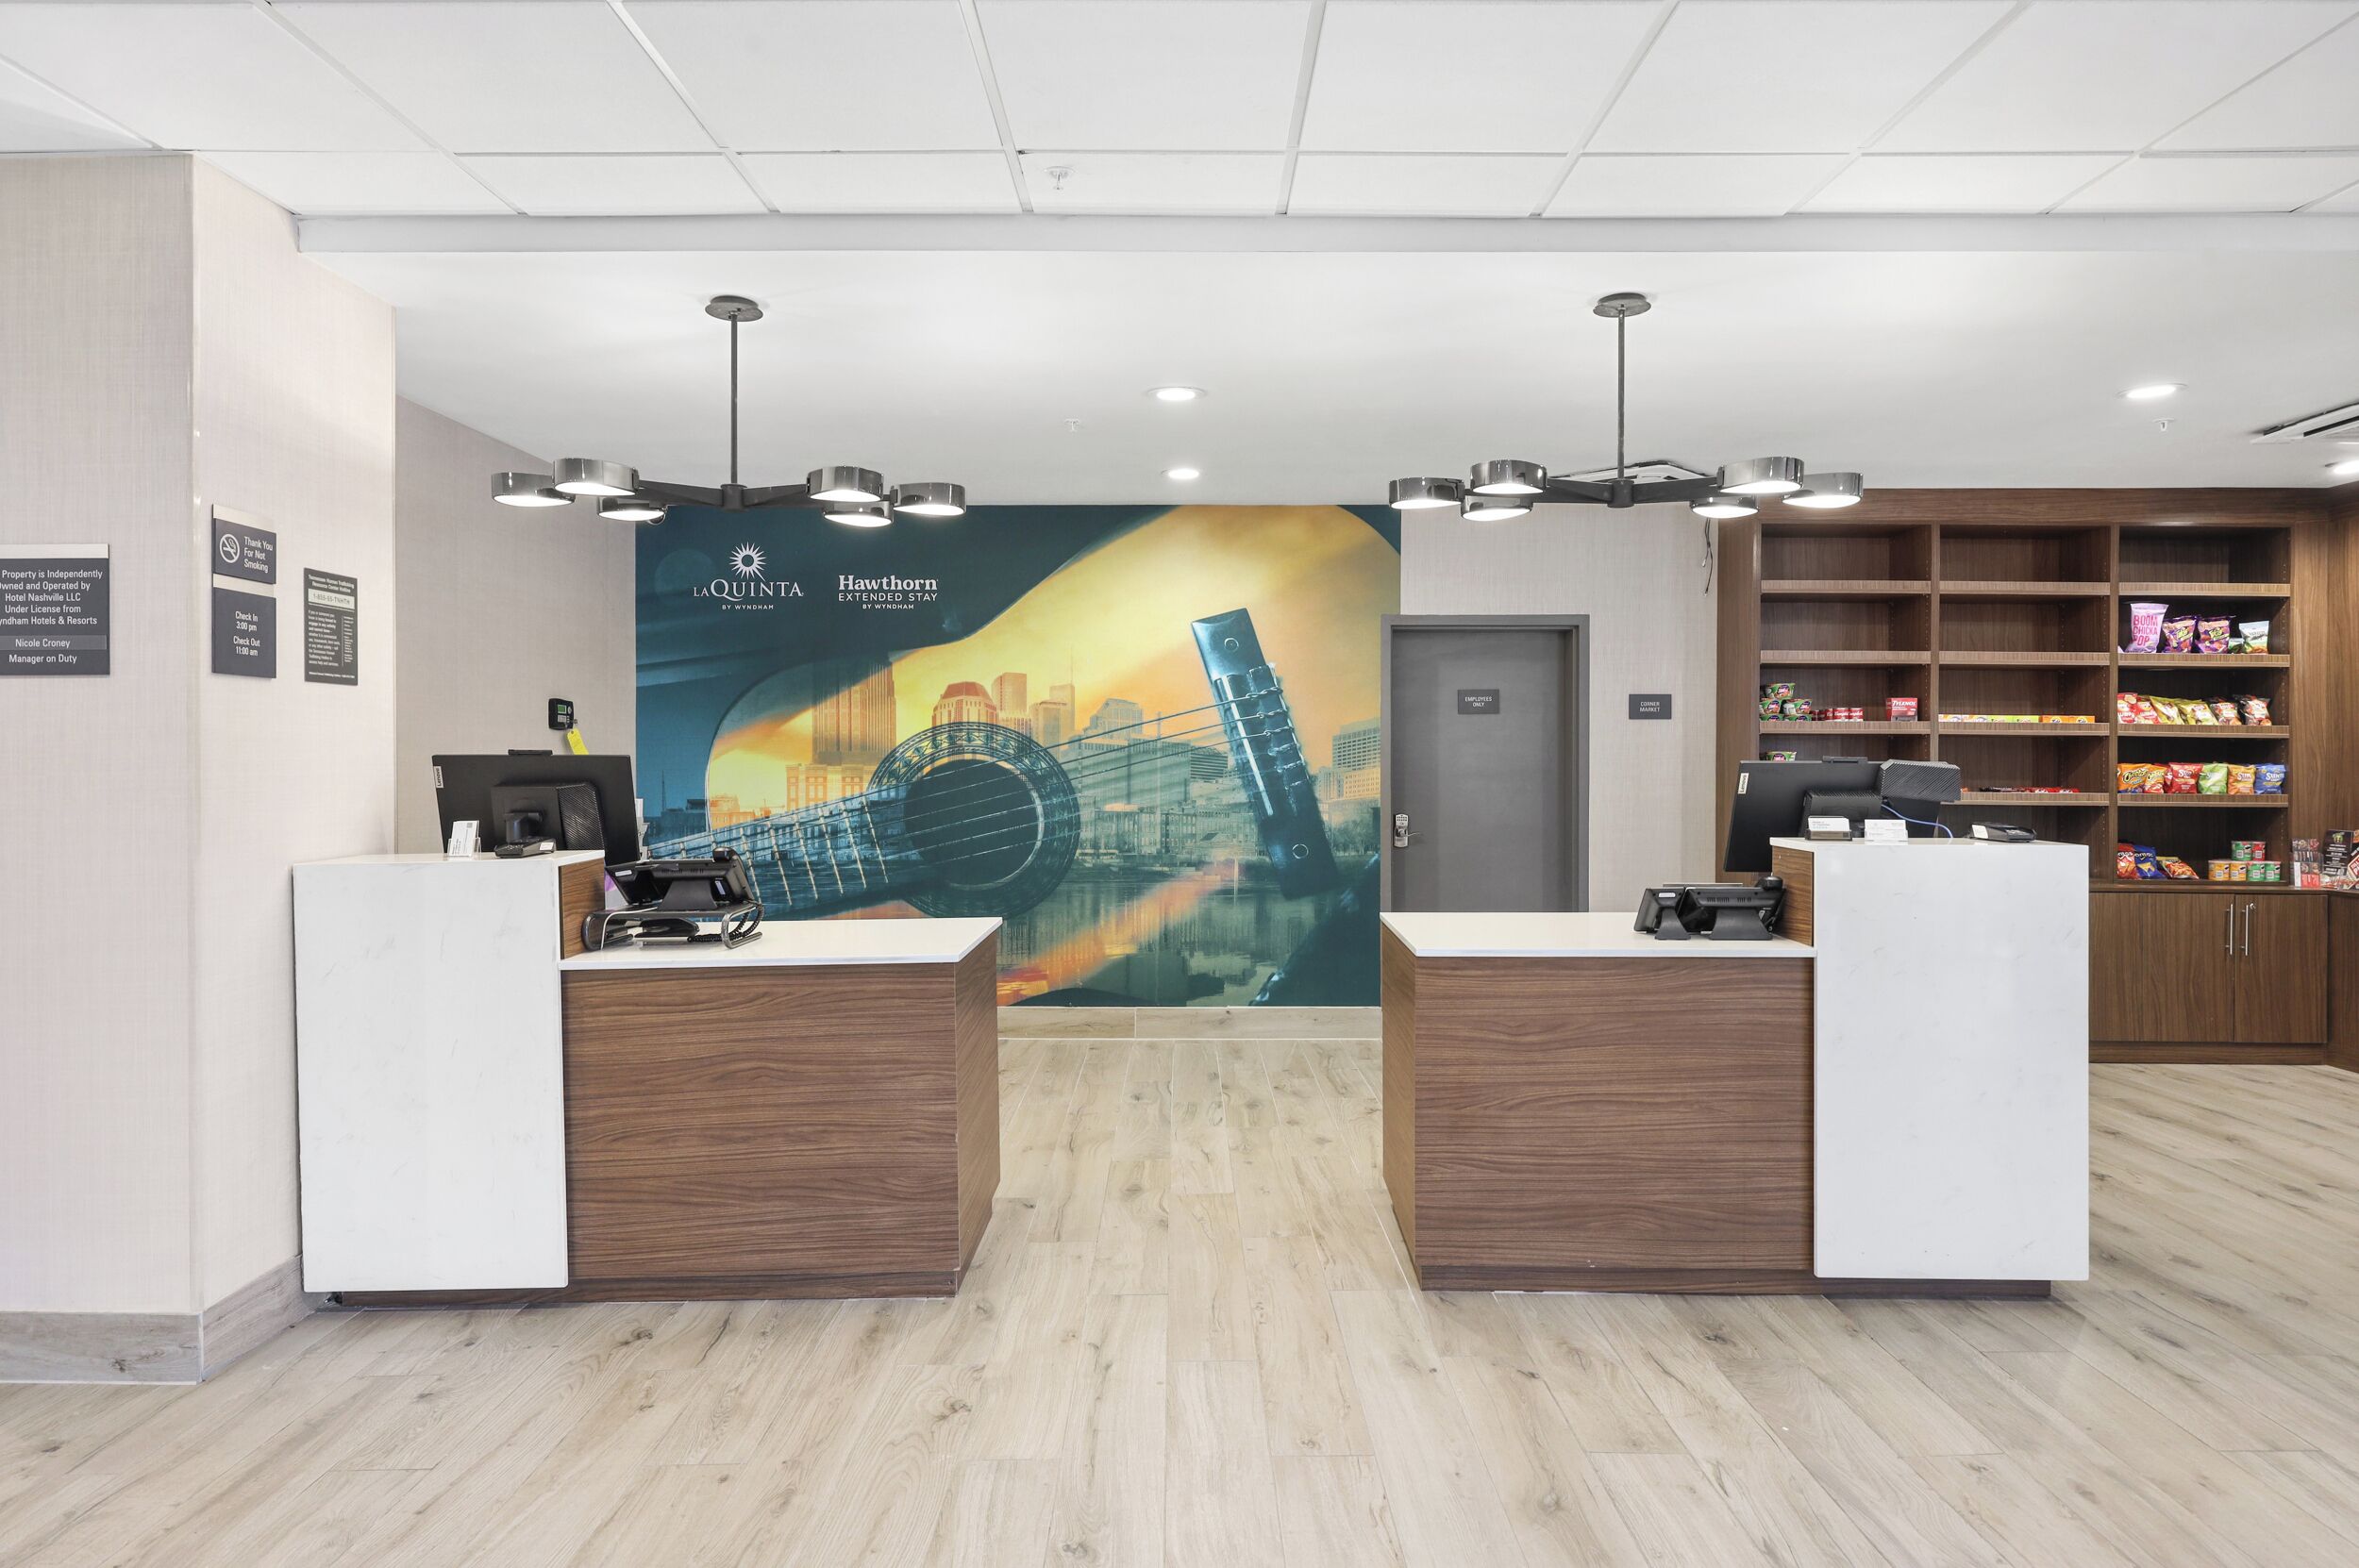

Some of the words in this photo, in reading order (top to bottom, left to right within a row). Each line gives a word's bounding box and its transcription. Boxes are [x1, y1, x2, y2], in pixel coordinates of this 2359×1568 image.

[244, 536, 261, 549] Thank
[262, 541, 273, 551] You
[243, 547, 254, 558] For
[255, 550, 265, 560] Not
[243, 559, 269, 574] Smoking
[2, 570, 36, 579] Property
[39, 570, 44, 578] is
[47, 569, 103, 579] Independently
[26, 581, 41, 590] and
[42, 581, 78, 592] Operated
[80, 581, 91, 592] by
[838, 575, 937, 591] Hawthorn
[5, 592, 25, 602] Hotel
[27, 592, 64, 602] Nashville
[66, 592, 81, 602] LLC
[838, 592, 903, 602] EXTENDED
[908, 592, 938, 602] STAY
[5, 605, 28, 613] Under
[30, 605, 60, 613] License
[62, 604, 81, 613] from
[0, 616, 28, 626] yndham
[31, 616, 56, 625] Hotels
[58, 616, 65, 625] &
[67, 616, 97, 625] Resorts
[235, 610, 252, 621] Check
[252, 613, 259, 623] In
[2133, 614, 2158, 626] BOOM
[236, 621, 247, 630] 3:00
[248, 624, 258, 632] pm
[2133, 626, 2158, 635] CHICKA
[15, 639, 40, 647] Nicole
[42, 638, 71, 648] Croney
[233, 635, 250, 645] Check
[250, 638, 260, 647] Out
[2133, 635, 2150, 646] POP
[236, 646, 249, 656] 11:00
[8, 654, 43, 664] Manager
[59, 654, 77, 664] Duty
